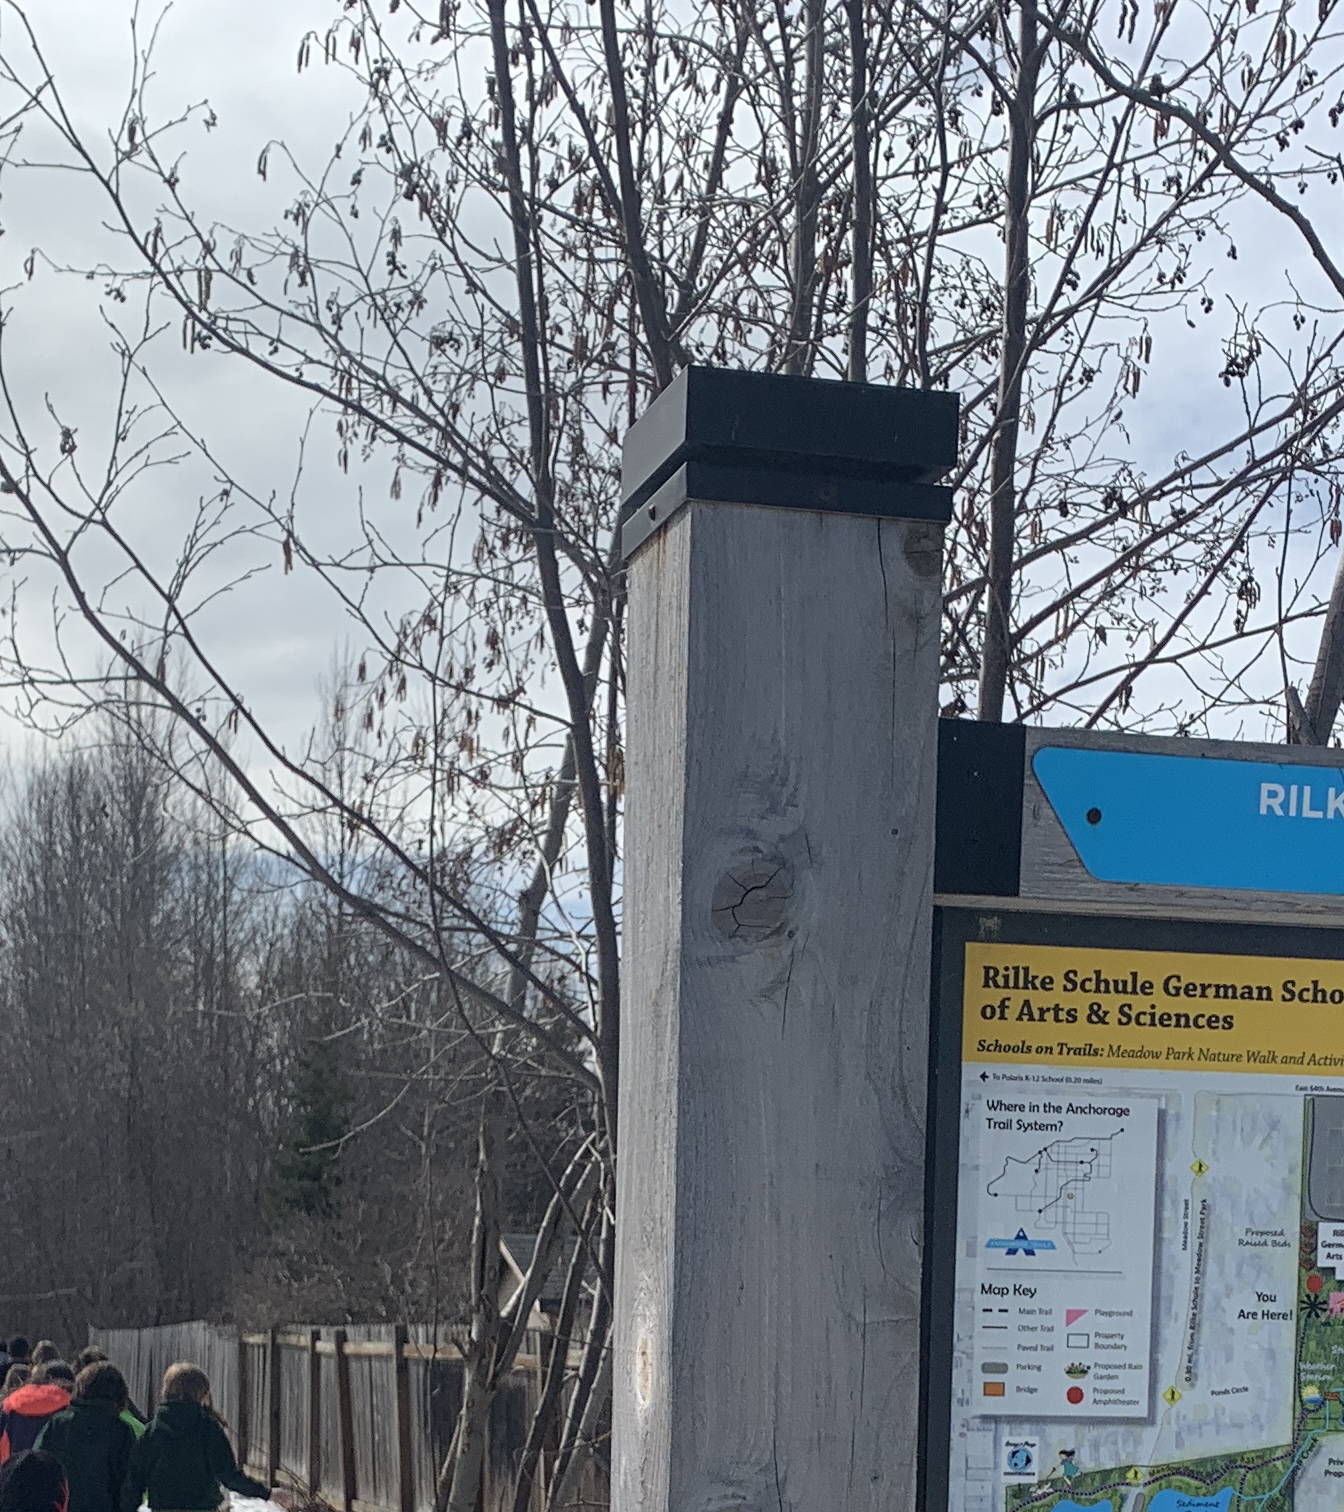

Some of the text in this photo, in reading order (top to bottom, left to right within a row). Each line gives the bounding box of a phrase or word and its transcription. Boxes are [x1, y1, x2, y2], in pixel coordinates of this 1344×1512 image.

[982, 966, 1054, 991] Rilke
[1063, 970, 1154, 995] Schule
[1163, 976, 1273, 1001] German
[980, 998, 1234, 1030] of Arts & Sciences
[977, 1039, 1032, 1054] Schools
[1035, 1046, 1054, 1055] on
[1057, 1043, 1104, 1057] Trails:
[1107, 1045, 1162, 1059] Meadow
[1165, 1047, 1195, 1061] Park
[1198, 1048, 1243, 1062] Nature
[1247, 1050, 1278, 1064] Walk
[1281, 1052, 1306, 1065] and
[987, 1100, 1130, 1117] Where in the Anchorage
[986, 1118, 1063, 1132] Trail System?
[1326, 1252, 1343, 1260] Arts
[981, 1283, 1037, 1298] Map Key
[1256, 1292, 1277, 1303] You
[1038, 1308, 1052, 1316] Trail
[1095, 1309, 1133, 1318] Playground
[1238, 1309, 1293, 1321] Are Here!
[1041, 1325, 1054, 1333] Trail
[1095, 1332, 1124, 1340] Property
[1016, 1364, 1042, 1372] Parking
[1094, 1362, 1127, 1370] Proposed
[1016, 1386, 1038, 1394] Bridge
[1093, 1387, 1125, 1395] Proposed
